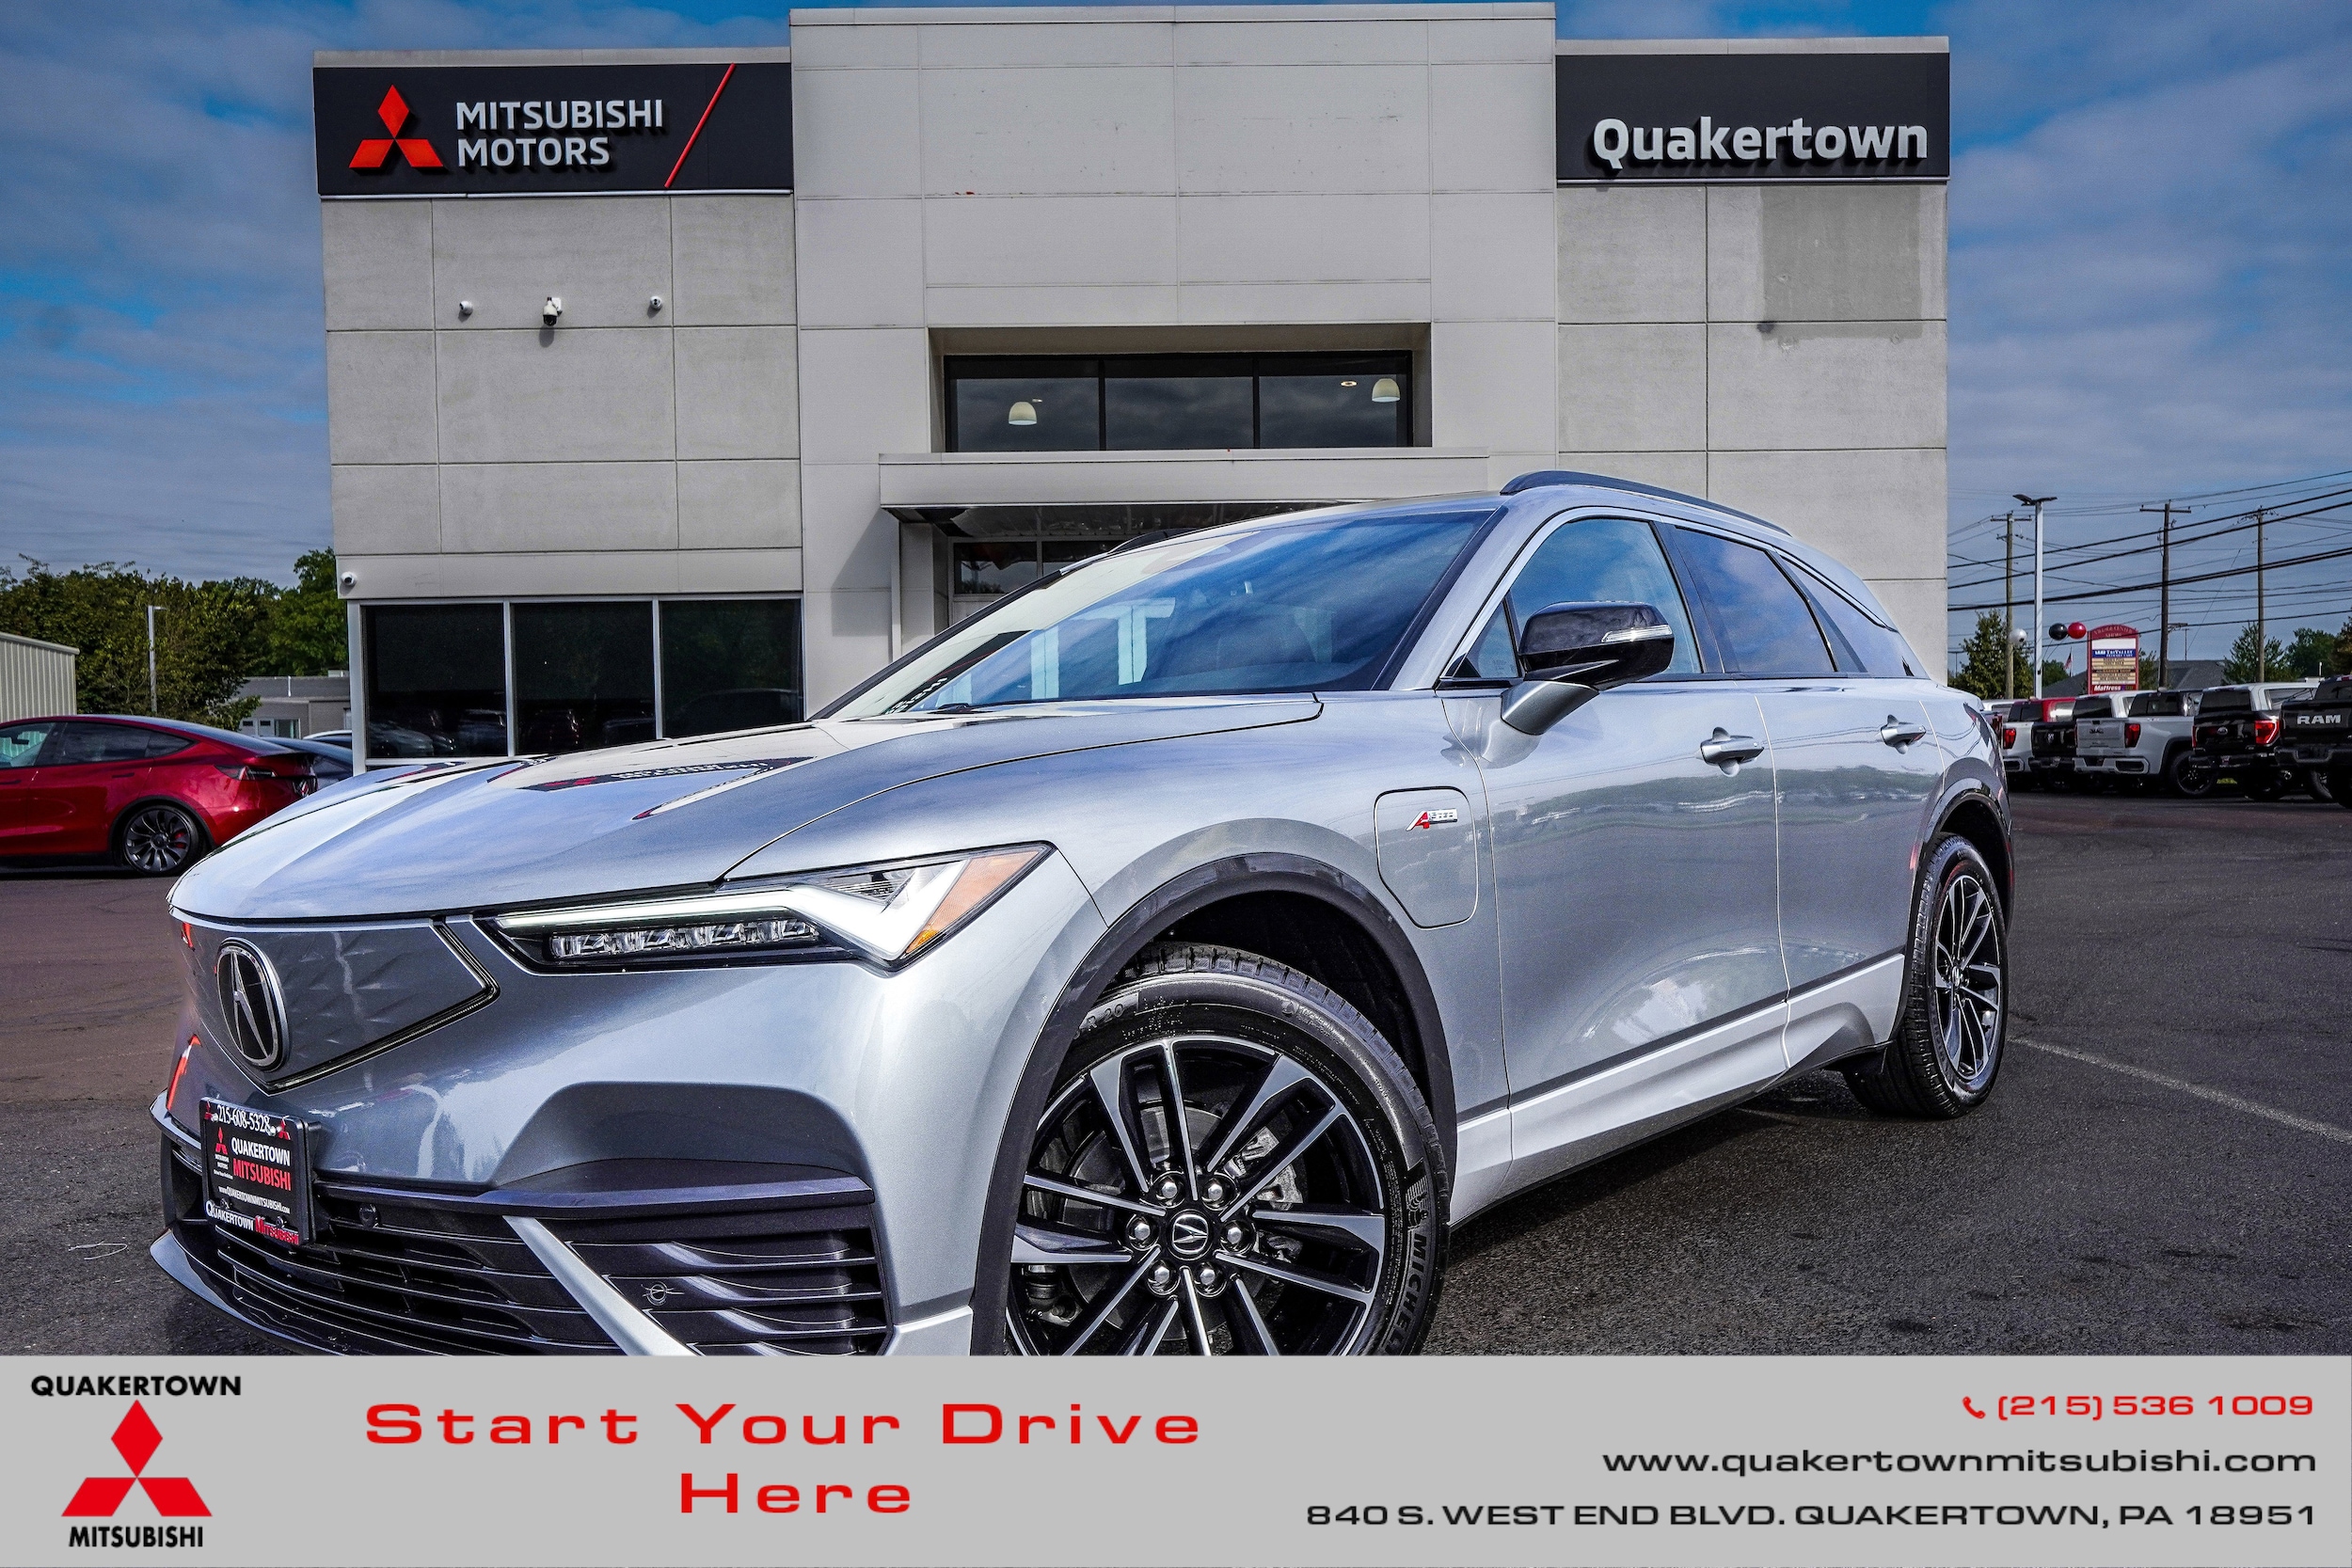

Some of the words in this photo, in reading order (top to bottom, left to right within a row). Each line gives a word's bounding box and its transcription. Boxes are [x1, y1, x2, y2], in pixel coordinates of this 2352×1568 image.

[456, 99, 662, 131] MITSUBISHI
[458, 136, 610, 167] MOTORS
[1594, 116, 1928, 170] Quakertown
[2296, 714, 2341, 725] RAM
[216, 1104, 272, 1133] 215-608-5328
[230, 1136, 291, 1166] QUAKERTOWN
[232, 1158, 292, 1191] MITSUBISHI
